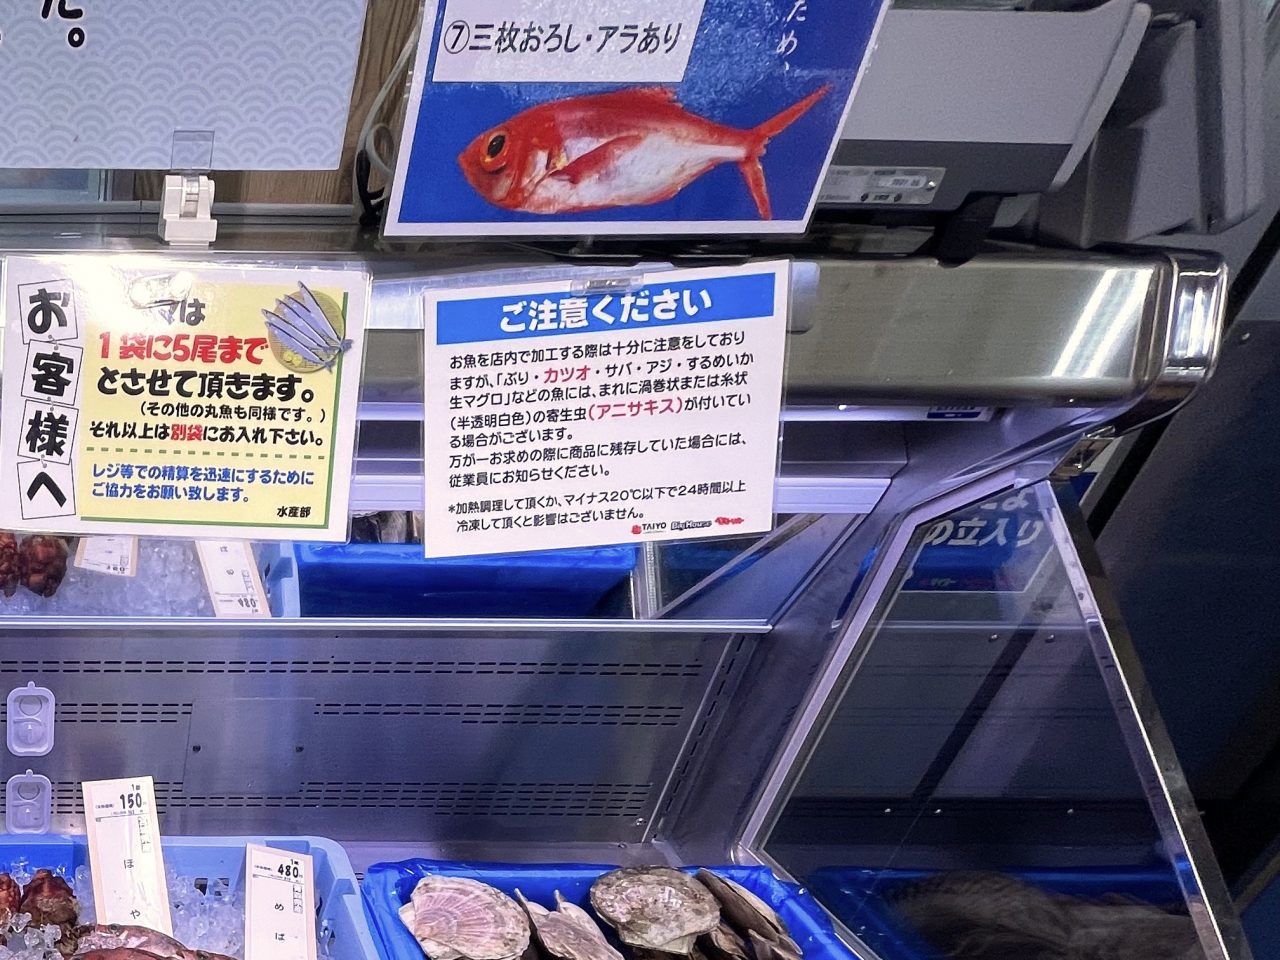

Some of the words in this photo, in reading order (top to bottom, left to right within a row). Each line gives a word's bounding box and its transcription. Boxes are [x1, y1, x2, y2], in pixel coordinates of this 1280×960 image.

[500, 288, 712, 333] ご注意ください
[98, 332, 270, 365] 1袋に5尾まで
[450, 331, 745, 369] お魚を店内で加工する際は十分に注意をしており
[96, 366, 315, 401] とさせて頂きます。
[26, 287, 74, 508] お客様へ
[89, 421, 324, 446] それ以上は別袋にお入れ下さい。
[450, 428, 573, 449] る場合がございます。
[449, 432, 747, 468] 万が一お求めの際に商品に残存していた場合には、
[92, 464, 314, 485] レジ等での精算を迅速にするために
[449, 466, 610, 489] 従業員にお知らせください。
[91, 481, 250, 503] ご協力をお願い致します。
[277, 505, 311, 518] 水産部
[456, 507, 645, 533] 冷凍して頂くと影響はございません。
[642, 522, 667, 530] TAIYO
[120, 792, 142, 809] 150
[278, 863, 299, 878] 480
[123, 858, 141, 920] ほや
